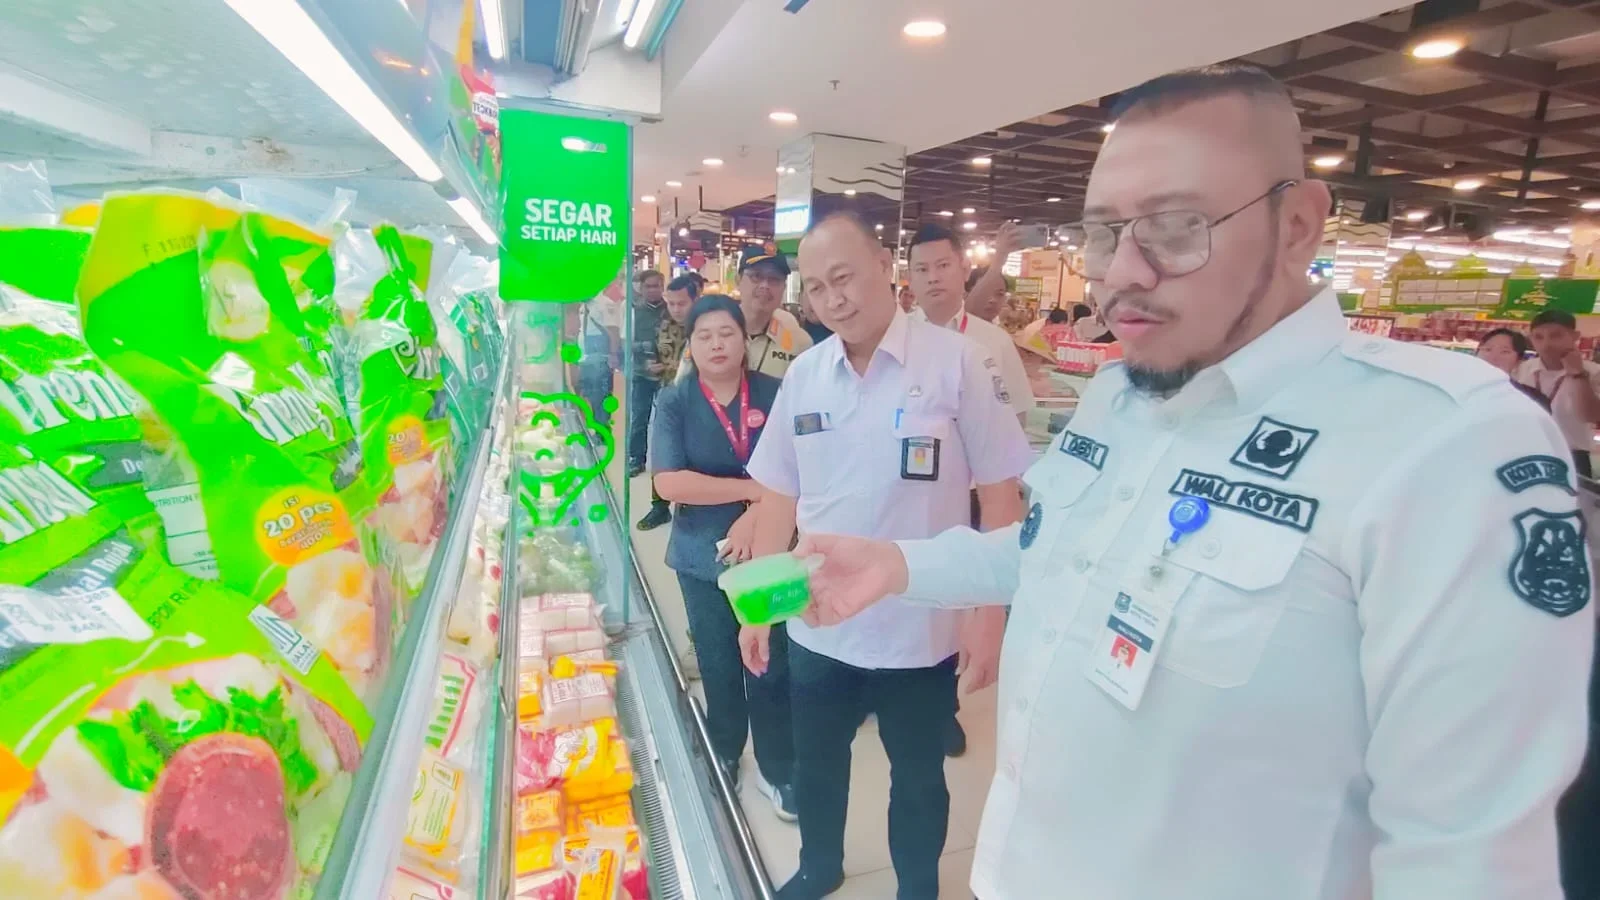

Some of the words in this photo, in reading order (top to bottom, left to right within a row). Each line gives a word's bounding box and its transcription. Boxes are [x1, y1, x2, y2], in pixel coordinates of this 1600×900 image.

[525, 198, 613, 228] SEGAR
[520, 225, 577, 242] SETIAP
[580, 229, 617, 246] HARI
[1183, 475, 1234, 503] WALI
[1236, 487, 1301, 522] KOTA
[263, 513, 295, 538] 20
